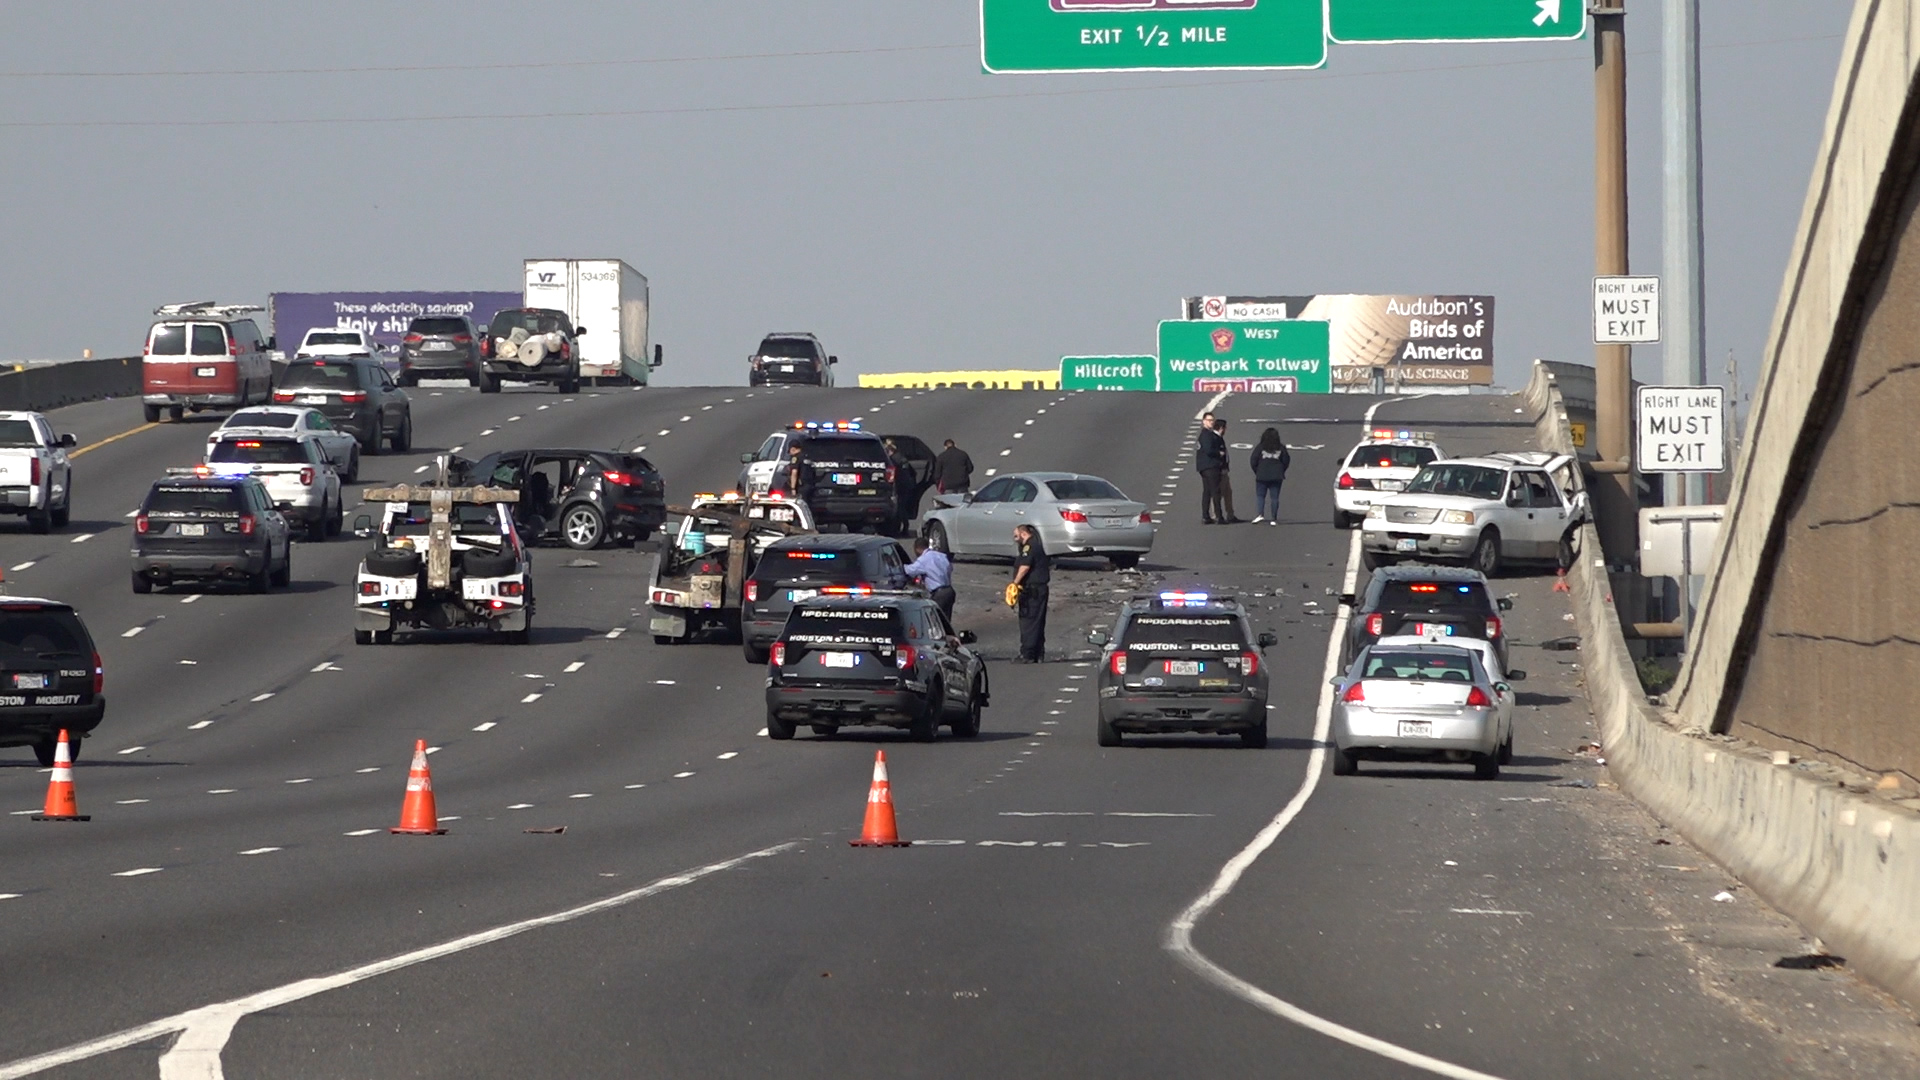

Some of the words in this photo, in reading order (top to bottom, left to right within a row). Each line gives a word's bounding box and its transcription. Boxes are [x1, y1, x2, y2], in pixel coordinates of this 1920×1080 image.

[1080, 29, 1122, 44] EXIT
[1181, 27, 1227, 43] MILE
[1598, 284, 1625, 293] RIGHT
[1631, 283, 1656, 293] LANE
[333, 301, 367, 313] These
[370, 302, 424, 316] electricity
[427, 301, 474, 316] savings?
[1233, 308, 1248, 316] NO
[1252, 307, 1279, 316] CASH
[1385, 297, 1483, 316] Audubon's
[1602, 299, 1650, 315] MUST
[337, 315, 378, 336] Holy
[1244, 327, 1279, 339] WEST
[1410, 319, 1458, 338] Birds
[1463, 319, 1485, 338] of
[1608, 320, 1646, 336] EXIT
[1402, 341, 1483, 360] America
[1074, 362, 1143, 379] Hillcroft
[1169, 357, 1249, 373] Westpark
[1256, 357, 1320, 374] Tollway
[1415, 369, 1469, 380] SCIENCE
[1645, 396, 1680, 408] RIGHT
[1687, 396, 1717, 408] LANE
[1650, 416, 1712, 434] MUST
[1657, 443, 1706, 463] EXIT
[853, 461, 886, 469] POLICE
[801, 610, 888, 619] HPDCAREER.COM
[789, 635, 833, 643] HOUSTON
[846, 635, 892, 644] POLICE
[1129, 643, 1178, 651] HOUSTON
[1191, 643, 1240, 651] POLICE
[35, 695, 81, 705] MOBILITY
